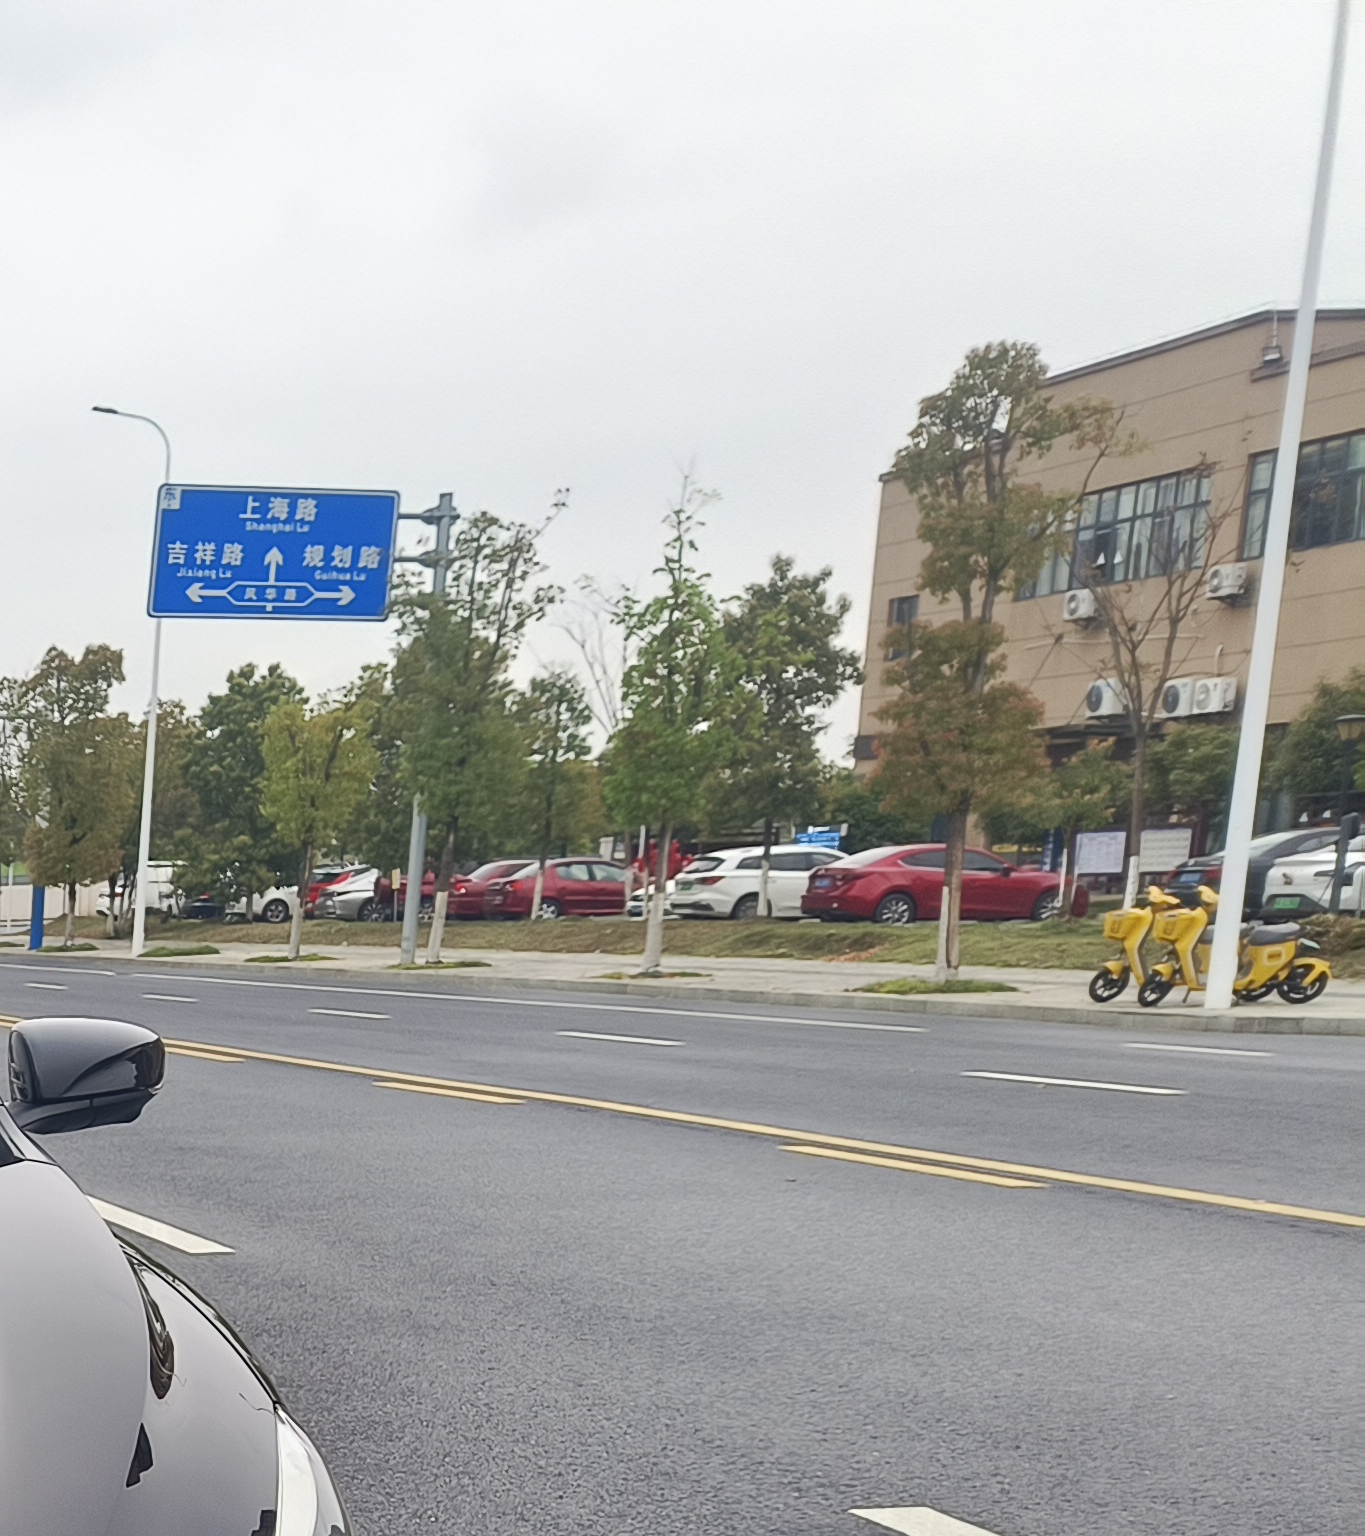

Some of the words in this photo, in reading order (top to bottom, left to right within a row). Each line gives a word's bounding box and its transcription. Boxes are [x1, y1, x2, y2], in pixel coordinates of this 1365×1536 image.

[238, 495, 318, 521] 上海路
[246, 520, 295, 534] Shanghai
[167, 540, 245, 566] 吉祥路
[302, 544, 381, 569] 规划路
[176, 566, 217, 580] Jixiang
